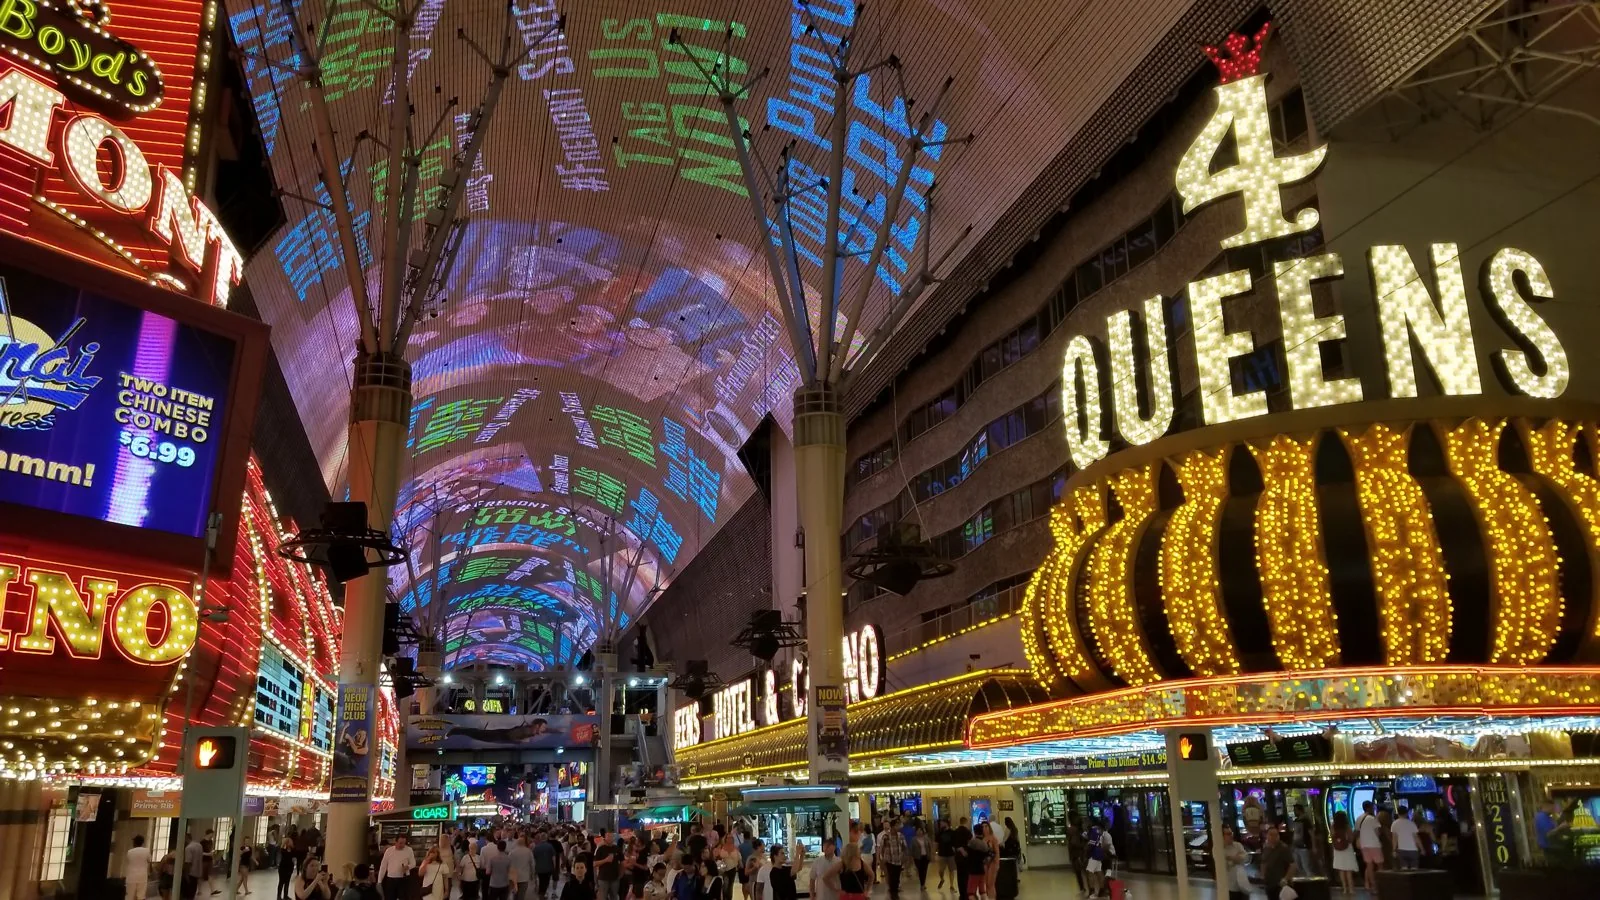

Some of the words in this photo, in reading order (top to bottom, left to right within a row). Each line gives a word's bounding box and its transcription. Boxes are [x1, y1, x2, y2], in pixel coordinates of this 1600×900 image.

[0, 0, 148, 97] Boyd's
[588, 18, 660, 79] US
[656, 12, 751, 199] NOW!
[543, 88, 611, 191] #FREMONT
[613, 101, 674, 169] TAG
[1175, 72, 1329, 250] 4
[838, 73, 948, 296] HERE
[274, 208, 341, 303] HERE
[741, 310, 782, 361] STREET
[1062, 241, 1570, 470] QUEENS
[117, 389, 210, 427] CHINESE
[118, 371, 166, 398] TWO
[170, 383, 214, 411] ITEM
[0, 410, 56, 430] ress
[114, 407, 208, 443] COMBO
[590, 405, 619, 424] US
[600, 426, 626, 449] TAG
[119, 430, 196, 468] $6.99
[616, 408, 657, 470] NOW!
[659, 417, 688, 468] PHOTO
[664, 462, 688, 503] YOUR
[688, 448, 721, 524] HERE
[343, 711, 366, 721] CLUB
[344, 693, 368, 703] NEON
[344, 702, 366, 712] HIGH
[713, 678, 756, 740] HOTEL
[764, 668, 780, 726] &
[818, 689, 843, 701] NOW
[1088, 757, 1106, 770] Prime
[1107, 756, 1118, 768] Rib
[1118, 755, 1140, 768] Dinner
[1141, 752, 1168, 767] $14.99
[413, 807, 449, 820] CIGARS
